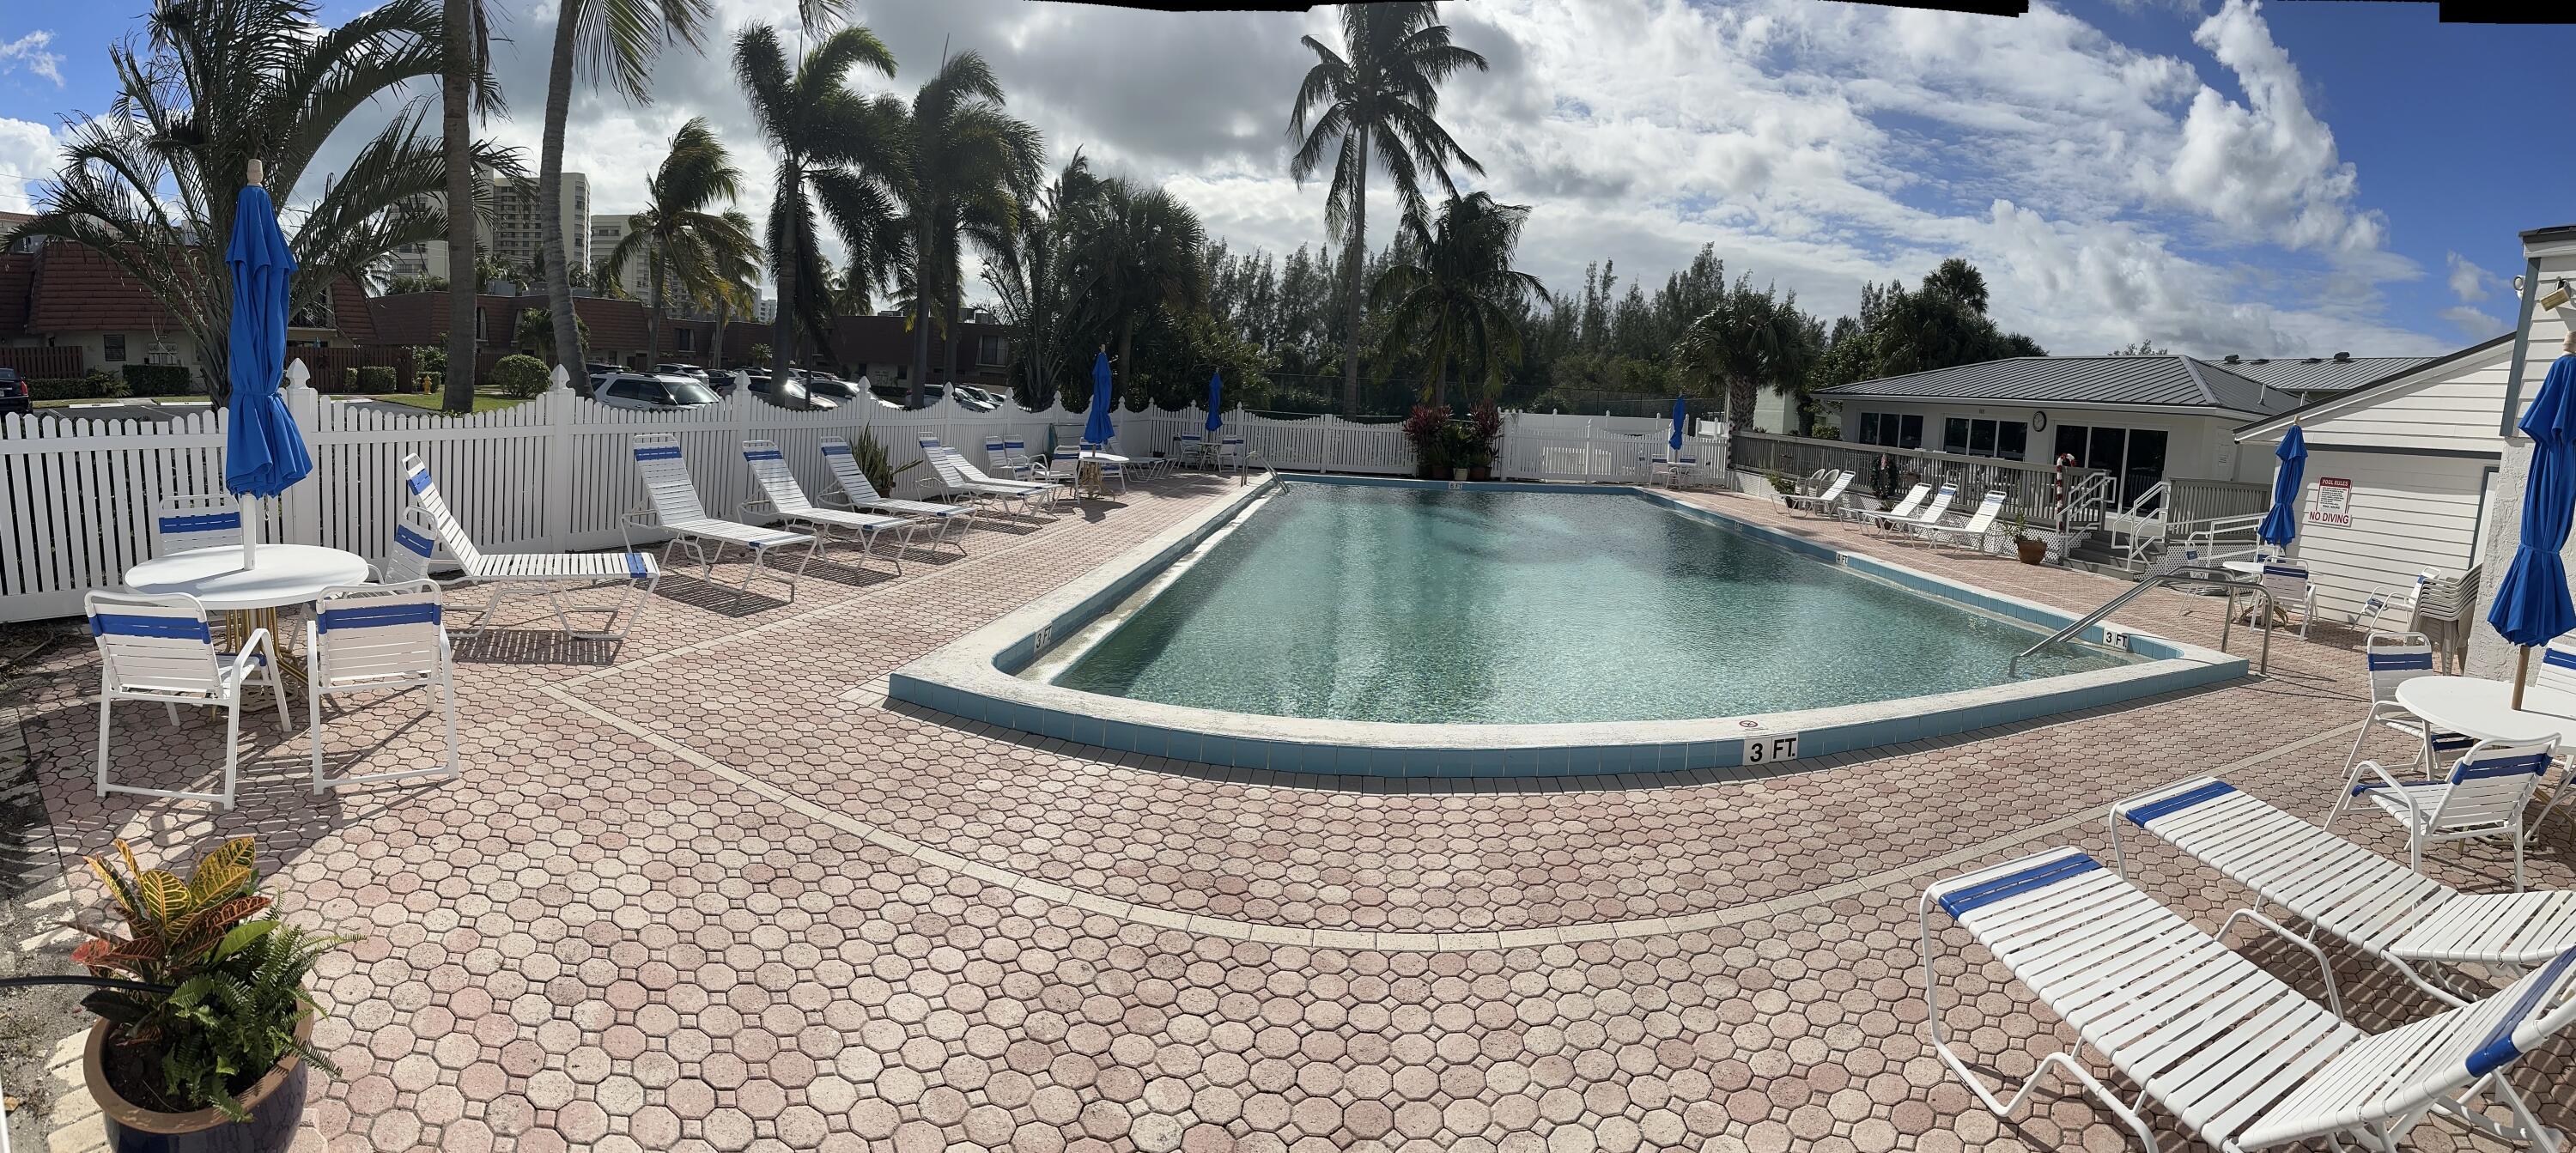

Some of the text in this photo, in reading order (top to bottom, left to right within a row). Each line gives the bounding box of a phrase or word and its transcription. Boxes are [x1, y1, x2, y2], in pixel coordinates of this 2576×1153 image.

[2309, 511, 2349, 525] NO DIVING
[1036, 633, 1042, 648] 3
[2105, 632, 2128, 648] 3 FT.
[1750, 737, 1797, 762] 3 FT.
